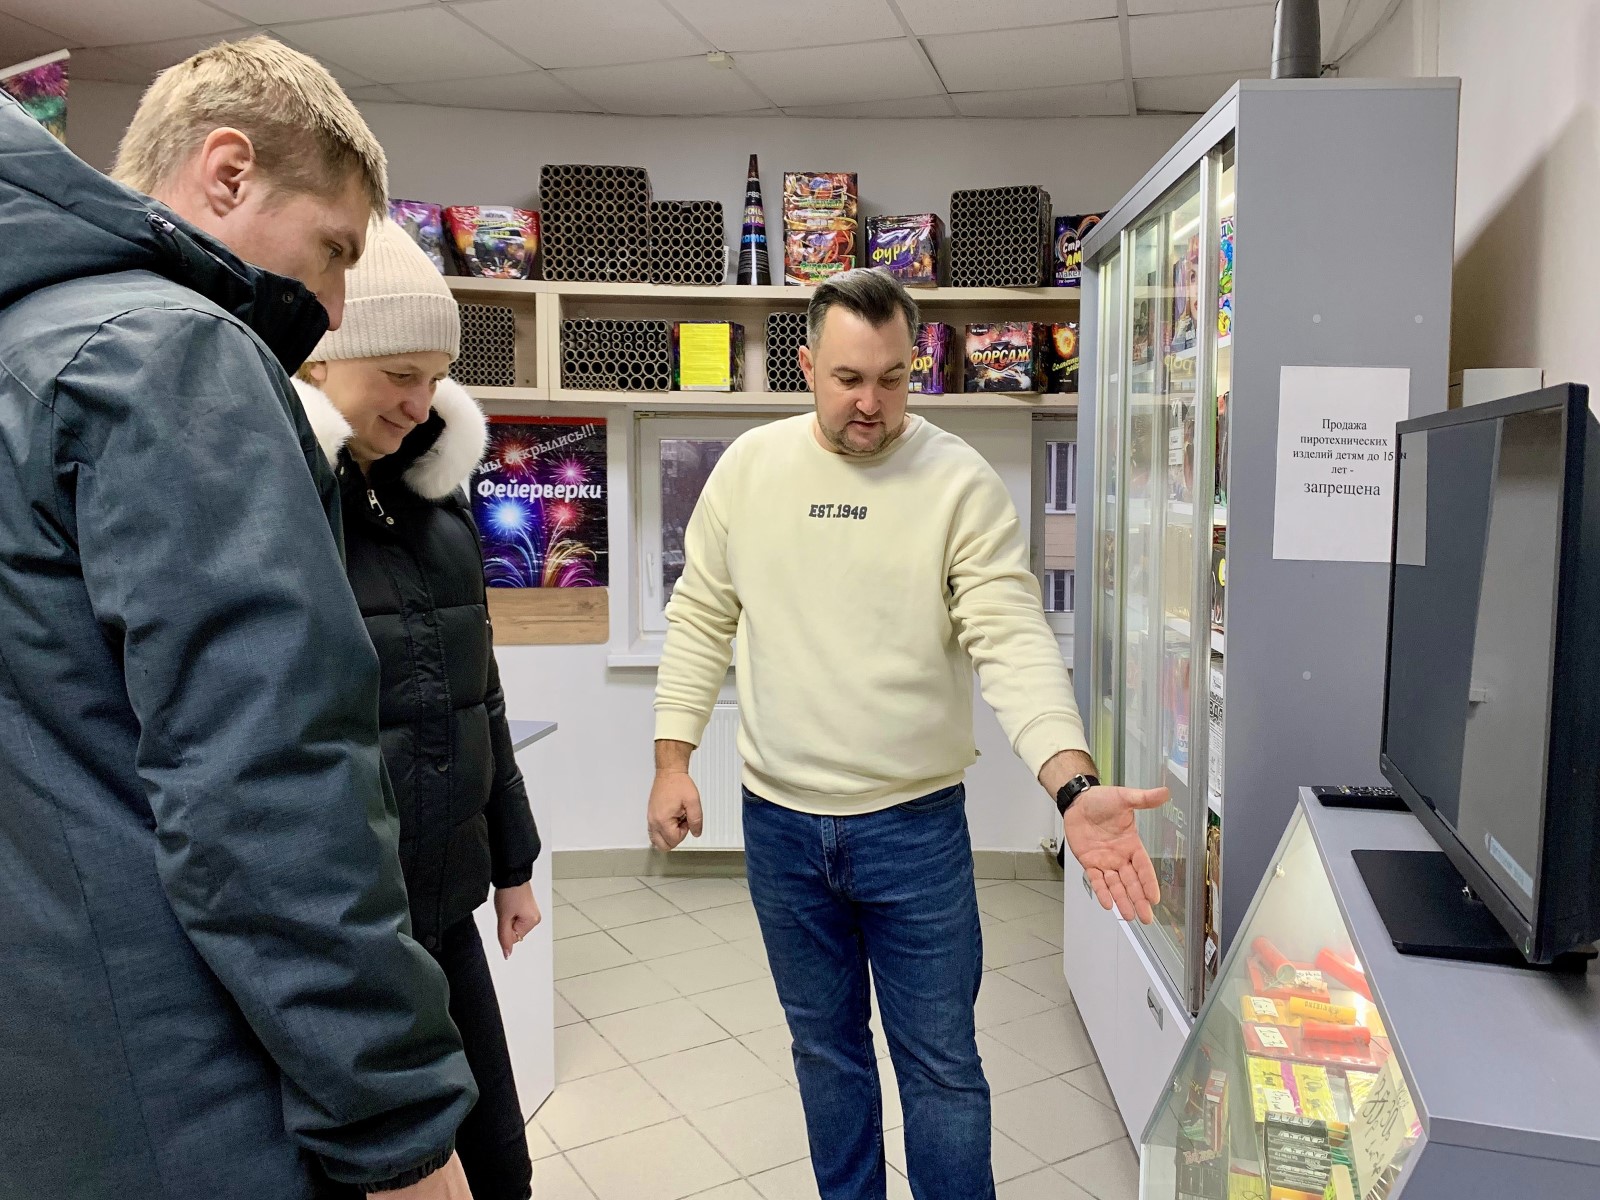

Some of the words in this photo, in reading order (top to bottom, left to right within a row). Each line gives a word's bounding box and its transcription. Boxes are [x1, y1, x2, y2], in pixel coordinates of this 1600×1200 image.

[970, 349, 1031, 364] ФОРСАЖ
[1322, 418, 1367, 432] Продажа
[505, 423, 596, 465] окрылись!!!
[1300, 435, 1388, 447] пиротехнических
[1293, 449, 1333, 460] изделий
[1335, 451, 1364, 461] детям
[1367, 452, 1380, 462] до
[1331, 465, 1347, 474] лет
[477, 479, 602, 503] Фейерверки
[1303, 482, 1381, 498] запрещена
[808, 503, 868, 520] EST.1948
